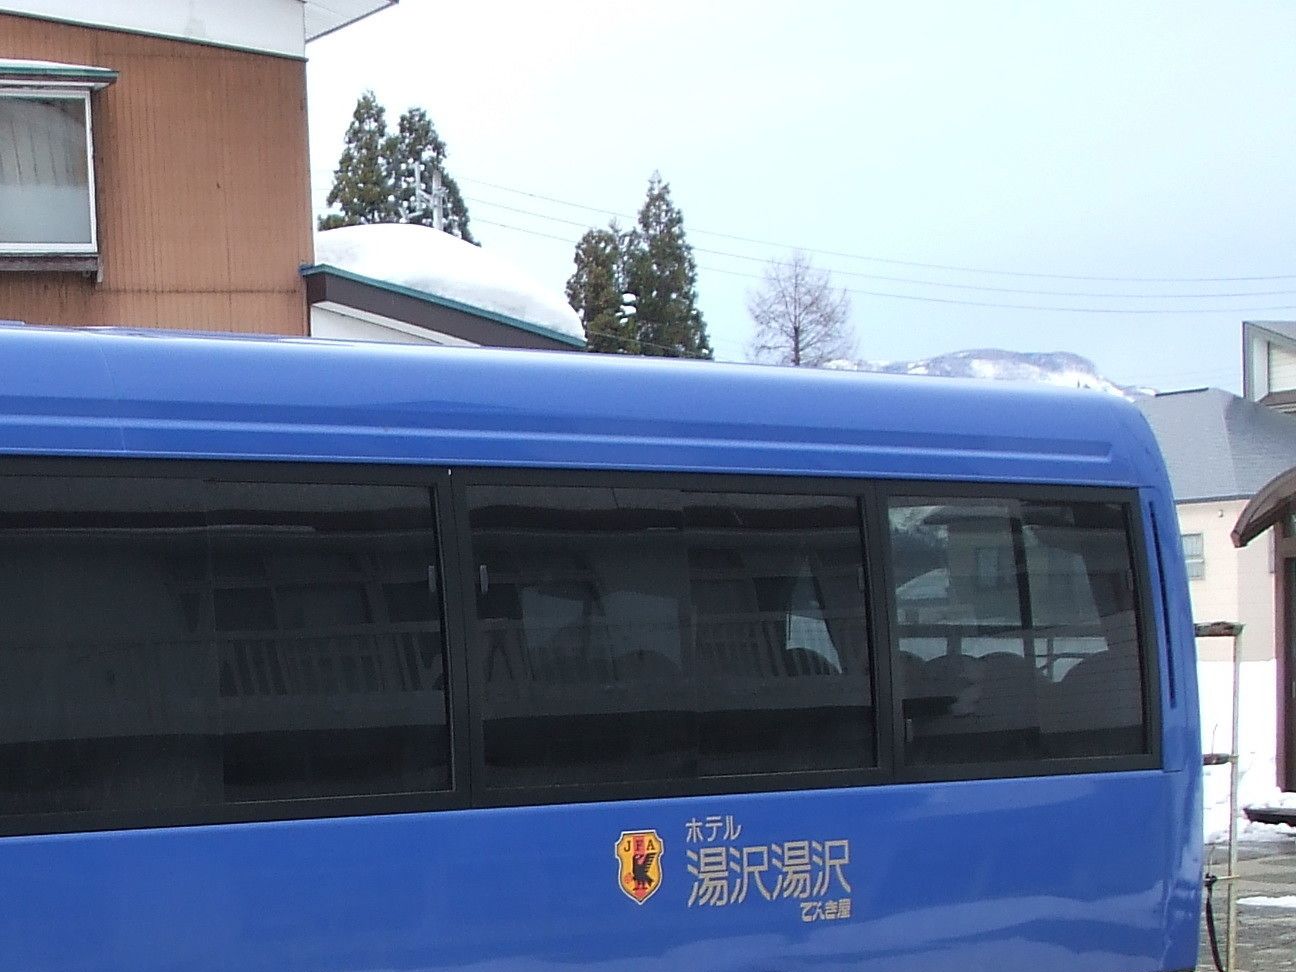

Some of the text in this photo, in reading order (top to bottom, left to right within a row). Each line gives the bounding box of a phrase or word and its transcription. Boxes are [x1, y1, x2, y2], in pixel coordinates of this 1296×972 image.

[685, 815, 741, 842] ホテル
[624, 840, 655, 852] JFA
[687, 839, 851, 907] 湯沢湯沢
